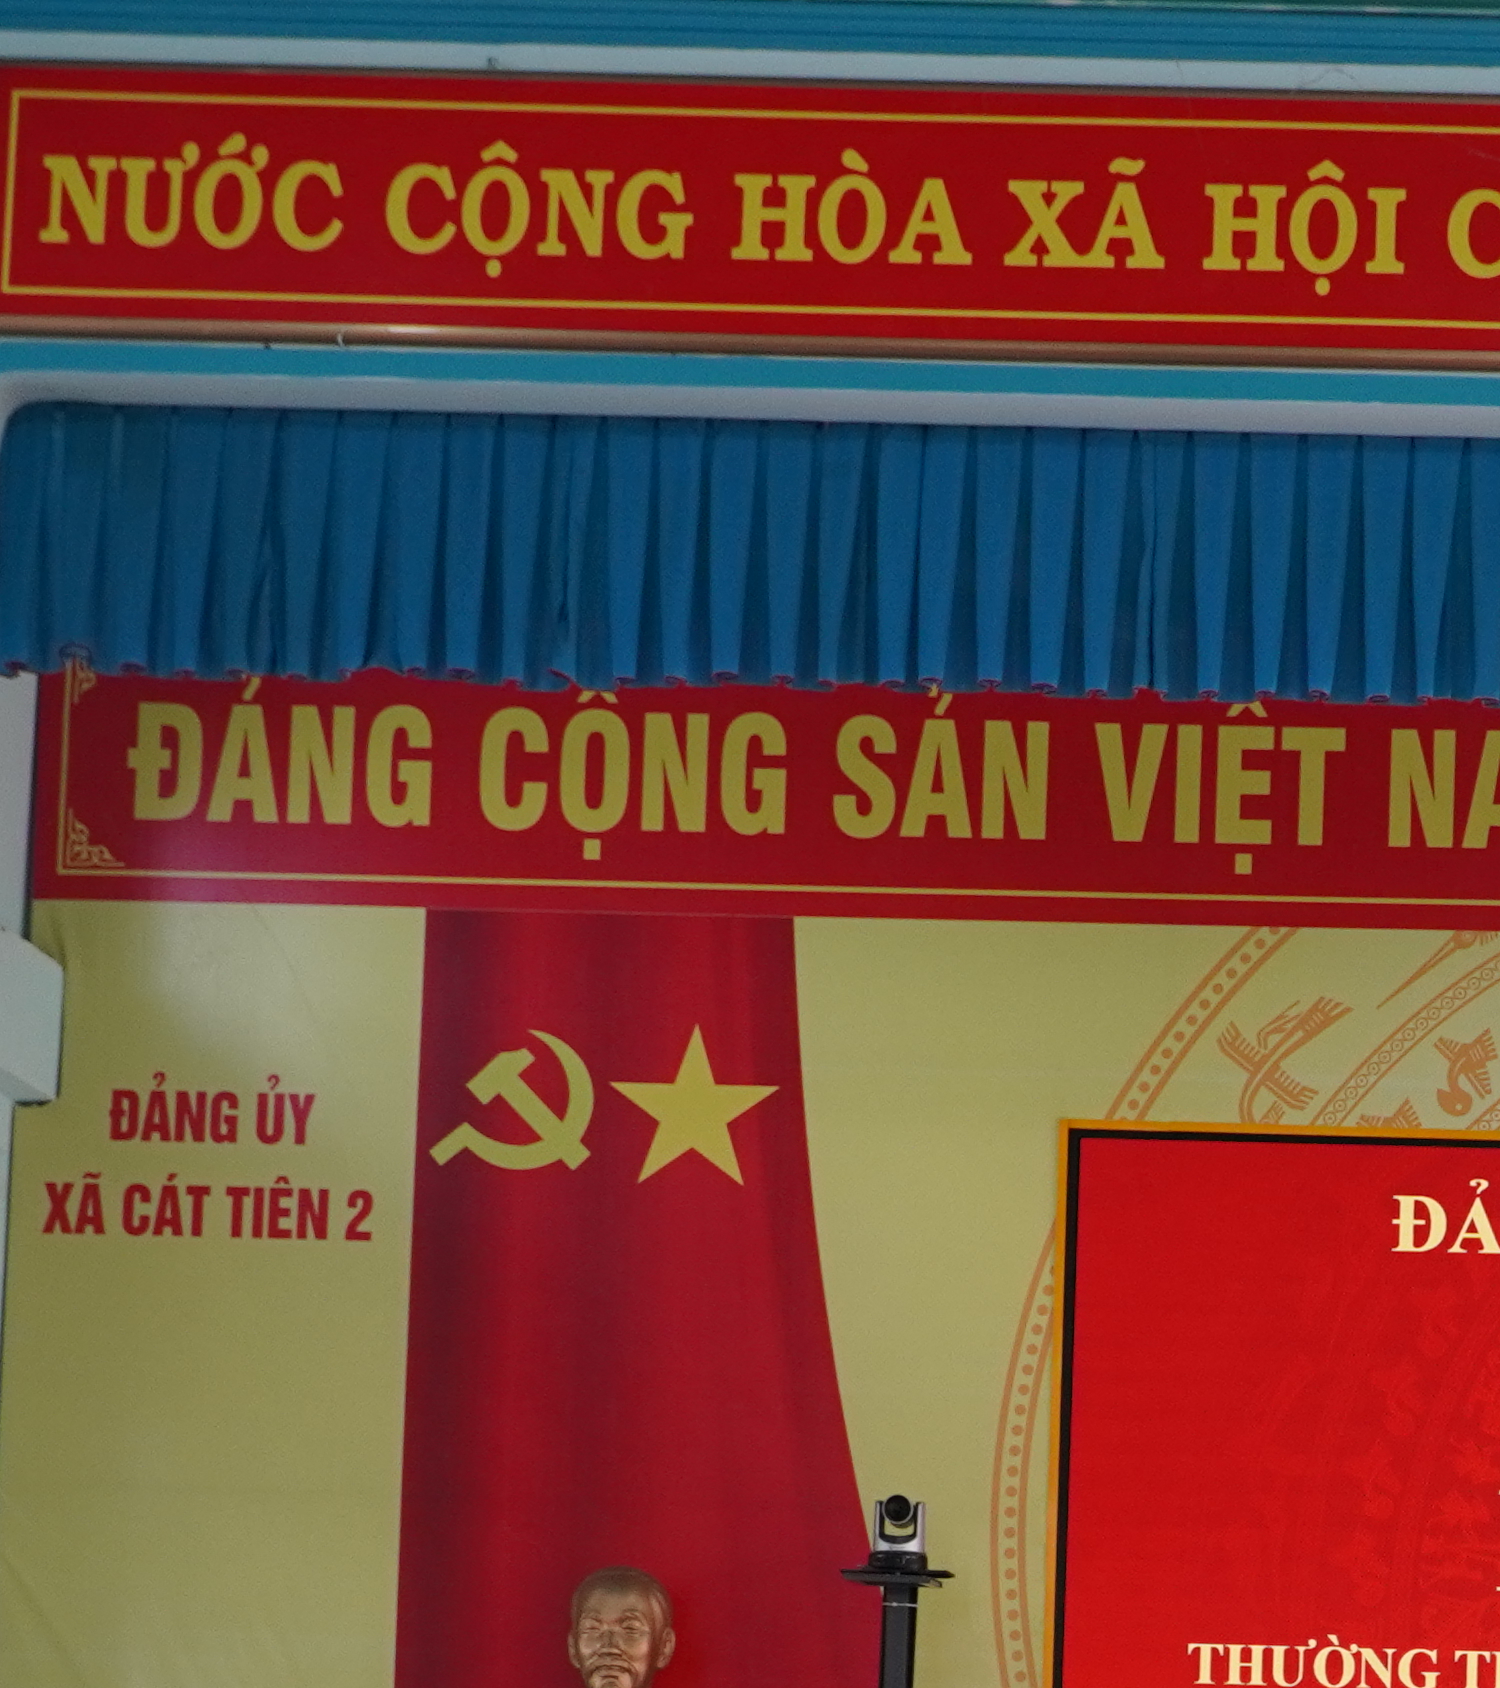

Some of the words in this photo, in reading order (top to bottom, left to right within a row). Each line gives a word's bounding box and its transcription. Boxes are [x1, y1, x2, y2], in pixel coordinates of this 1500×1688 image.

[39, 133, 343, 251] NƯỚC
[385, 140, 694, 277] CỘNG
[731, 149, 972, 265] HÒA
[1004, 157, 1165, 269] XÃ
[1203, 160, 1406, 296] HỘI
[479, 683, 786, 860] CỘNG
[1095, 693, 1346, 874] VIỆT
[109, 1072, 238, 1143] ĐẢNG
[256, 1074, 315, 1145] ỦY
[43, 1172, 105, 1235] XÃ
[122, 1173, 211, 1237] CÁT
[226, 1176, 329, 1240] TIÊN
[345, 1190, 373, 1241] 2
